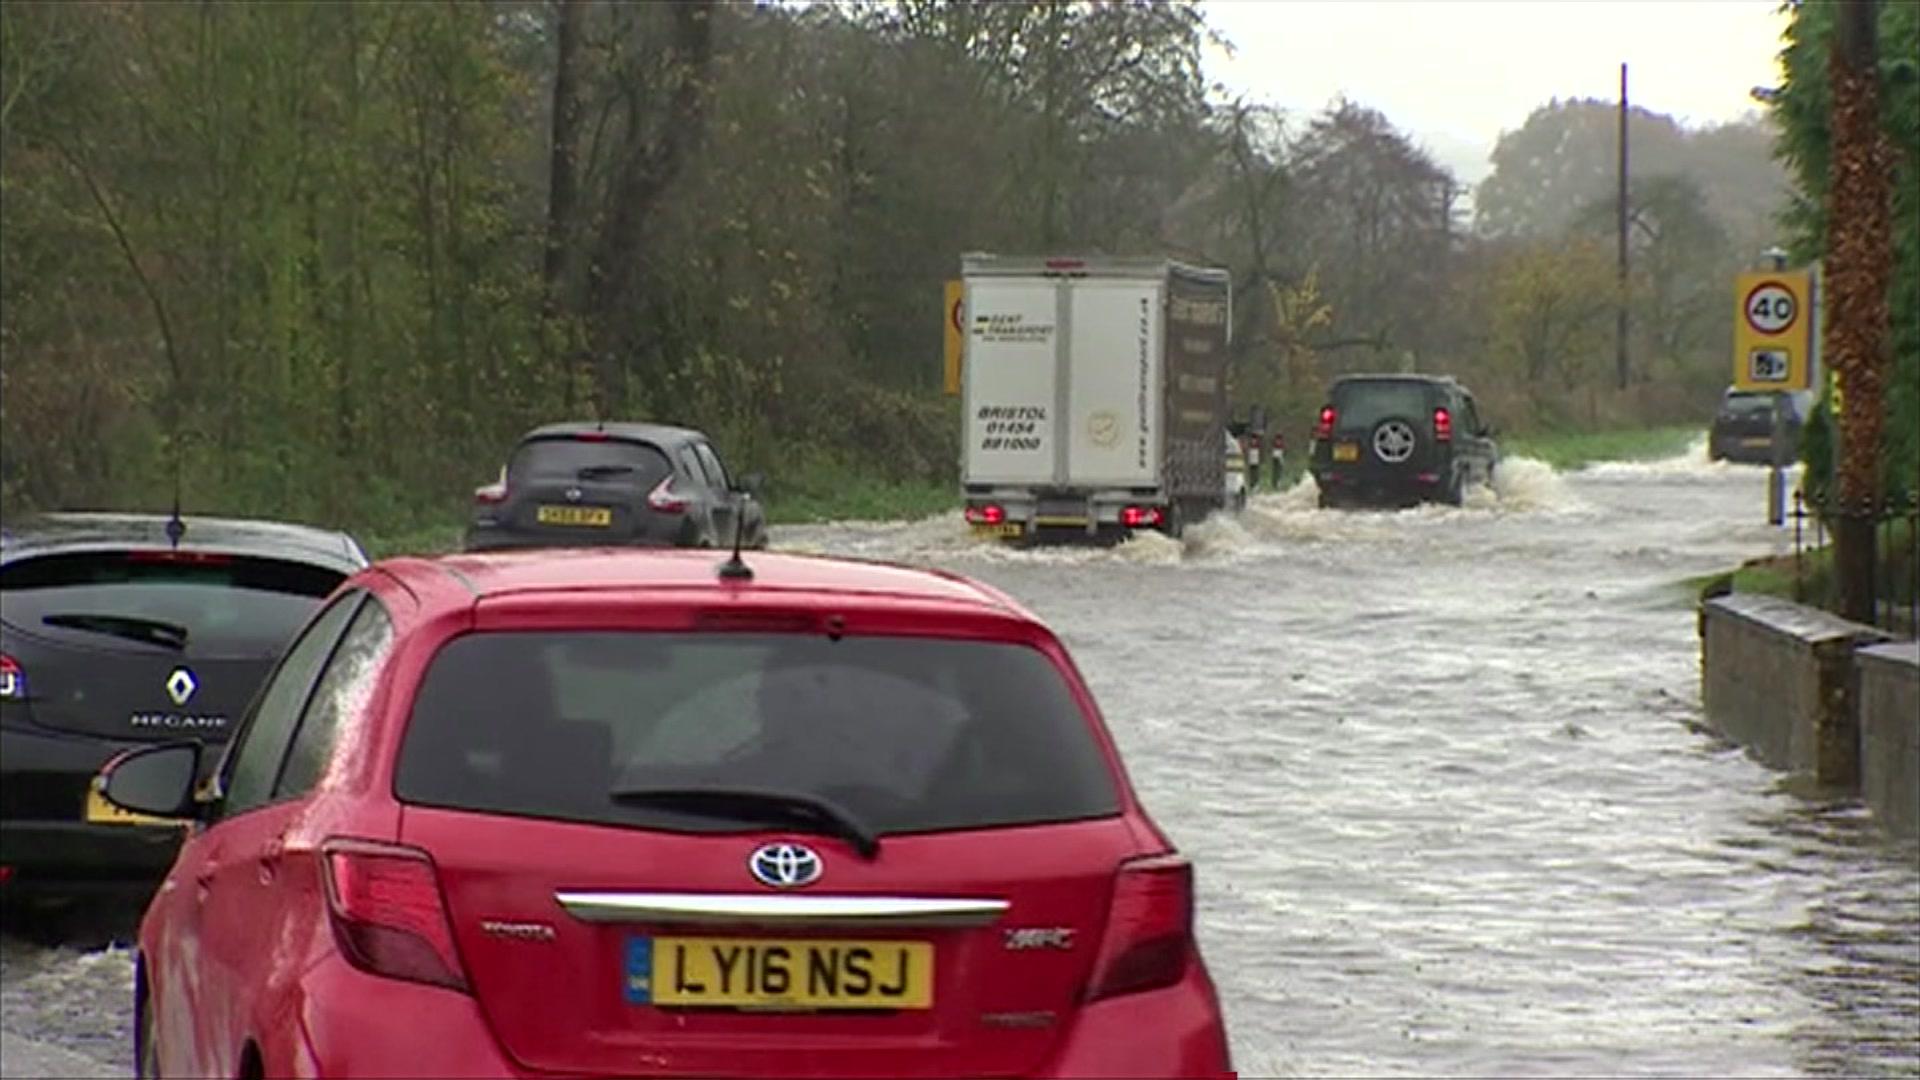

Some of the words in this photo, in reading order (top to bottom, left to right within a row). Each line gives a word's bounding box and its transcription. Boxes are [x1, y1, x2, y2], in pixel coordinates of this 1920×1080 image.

[1752, 296, 1792, 320] 40
[978, 406, 1046, 420] BRISTOL
[986, 421, 1035, 434] 01454
[130, 714, 227, 728] MEGANE
[674, 943, 792, 994] LY16
[807, 947, 909, 998] NSJ
